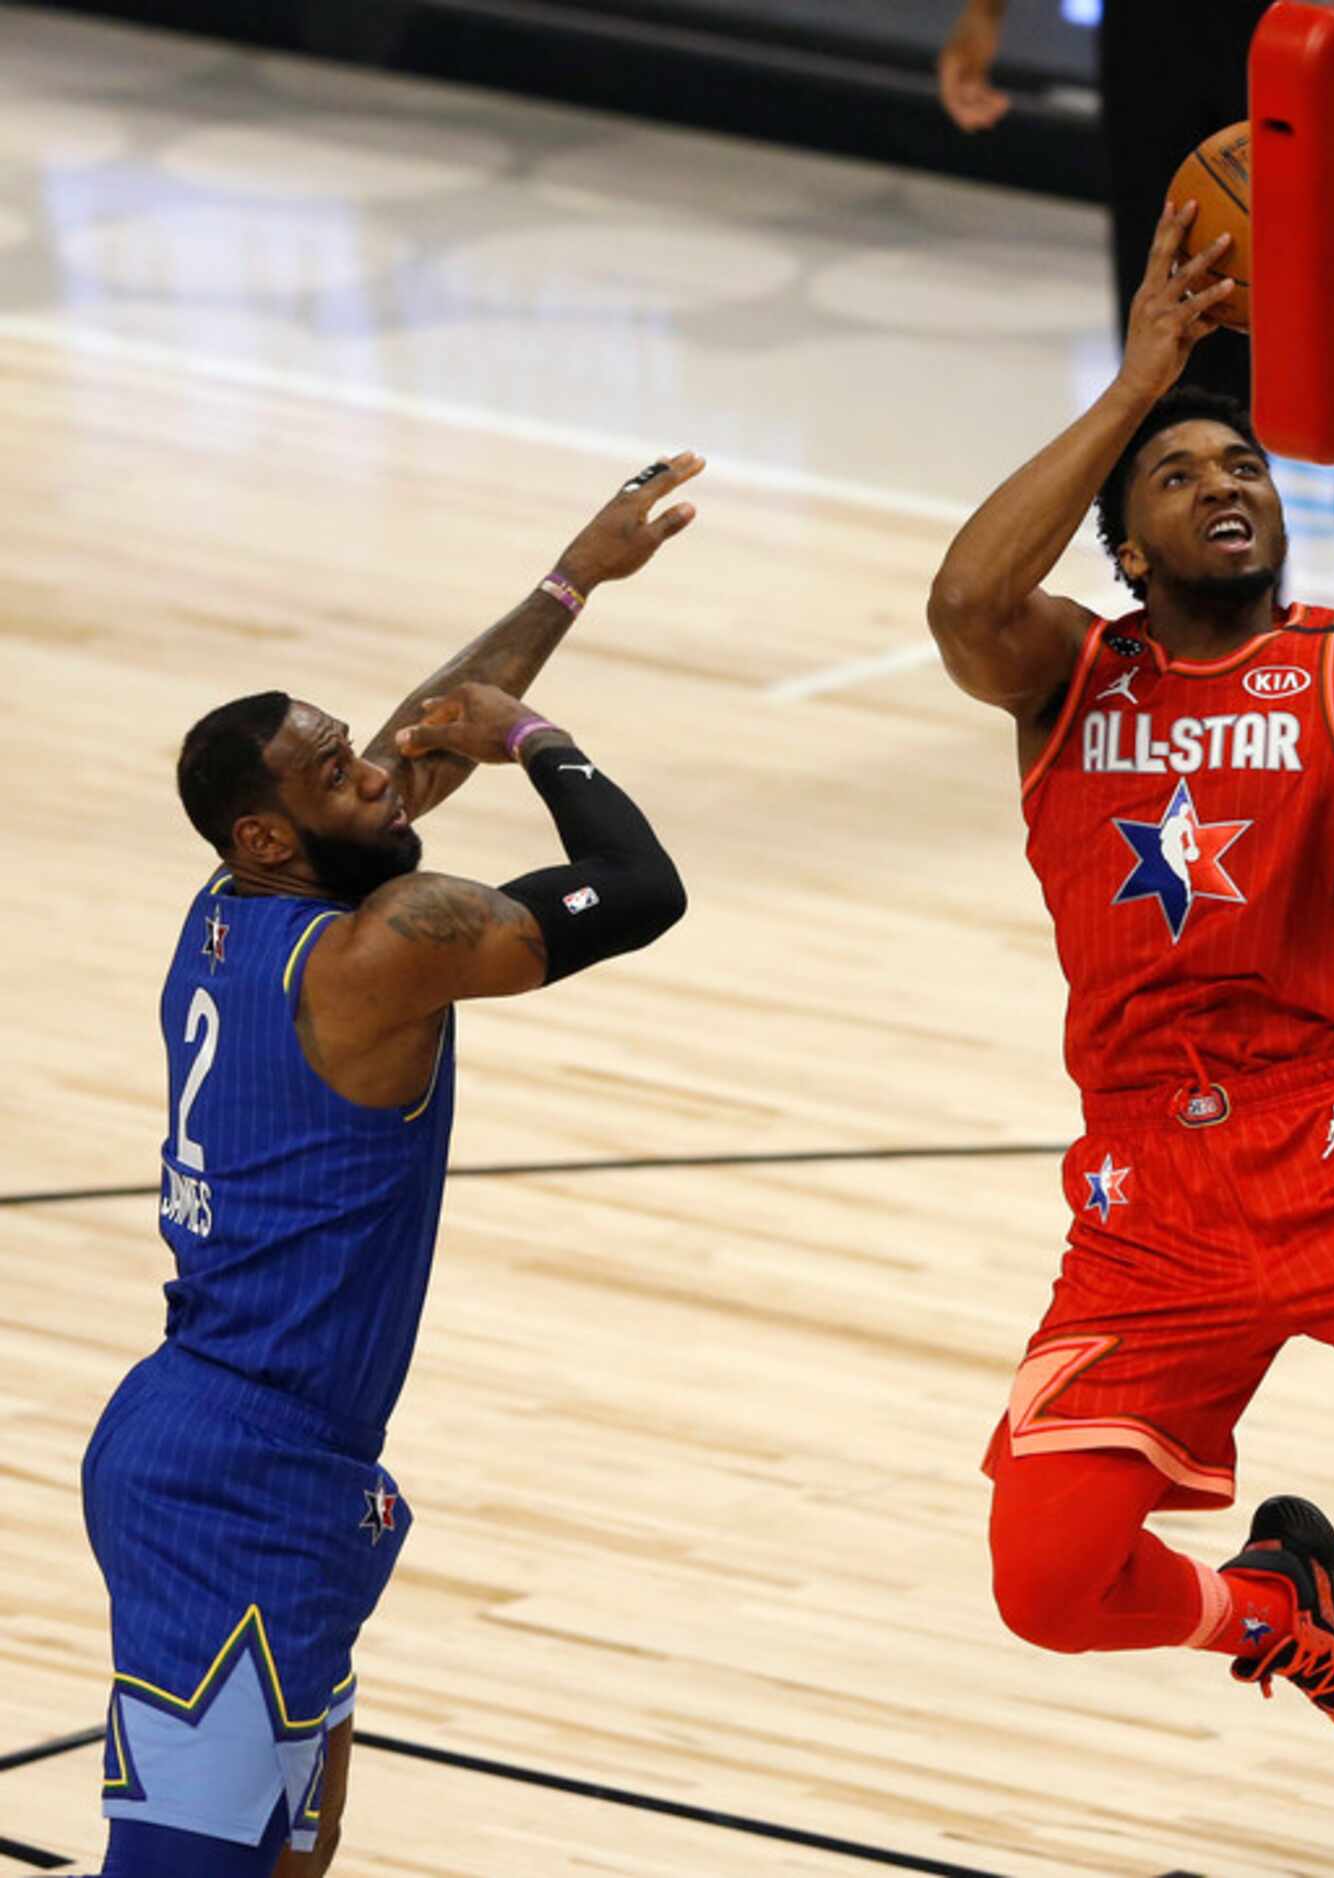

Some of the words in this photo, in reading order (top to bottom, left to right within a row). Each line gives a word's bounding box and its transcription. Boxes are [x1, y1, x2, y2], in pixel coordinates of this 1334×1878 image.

[1253, 671, 1300, 691] KIA
[1083, 709, 1303, 774] ALL-STAR
[176, 986, 221, 1173] 2
